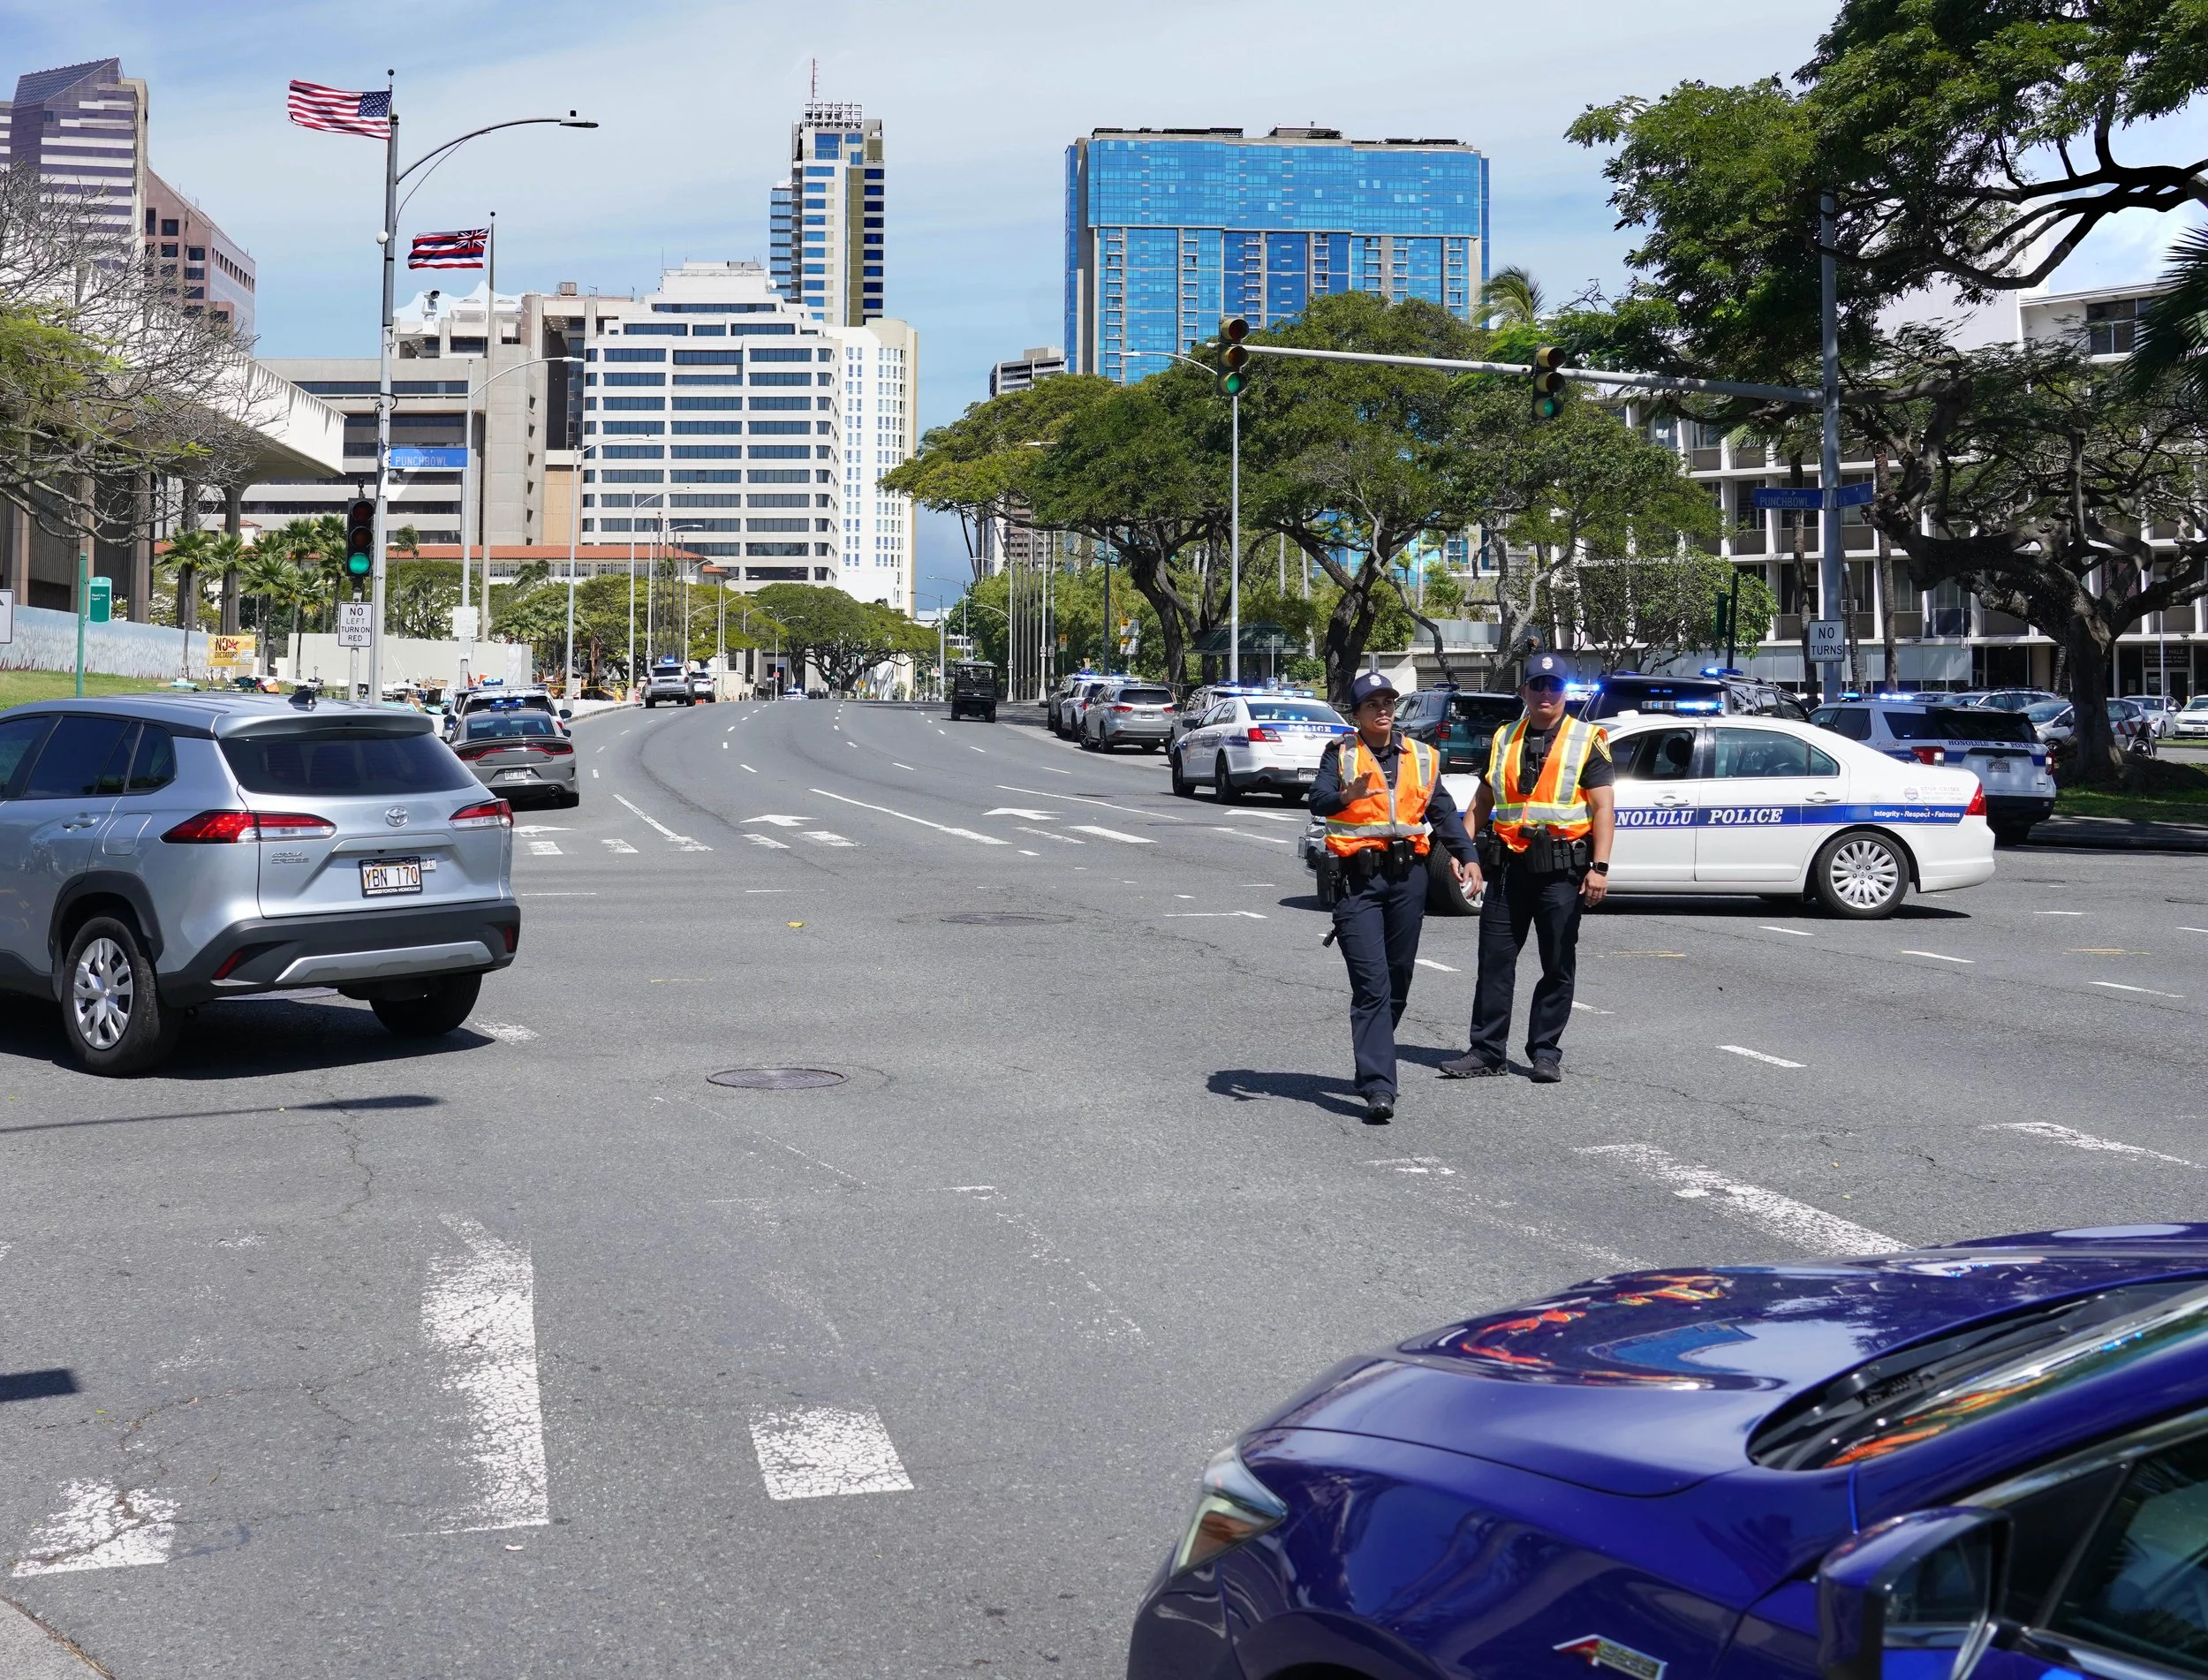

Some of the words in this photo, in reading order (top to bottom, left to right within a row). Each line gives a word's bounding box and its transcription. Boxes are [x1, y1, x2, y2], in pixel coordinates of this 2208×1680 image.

[395, 456, 449, 466] PUNCHBOWL
[1759, 496, 1810, 507] PUNCHBOWL
[350, 607, 364, 617] NO
[1818, 626, 1835, 639] NO
[1811, 645, 1843, 655] TURNS
[1288, 724, 1332, 733] POLICE
[1614, 810, 1694, 826] NOLULU
[1708, 808, 1784, 824] POLICE
[364, 867, 389, 888] YBN
[396, 866, 419, 886] 170
